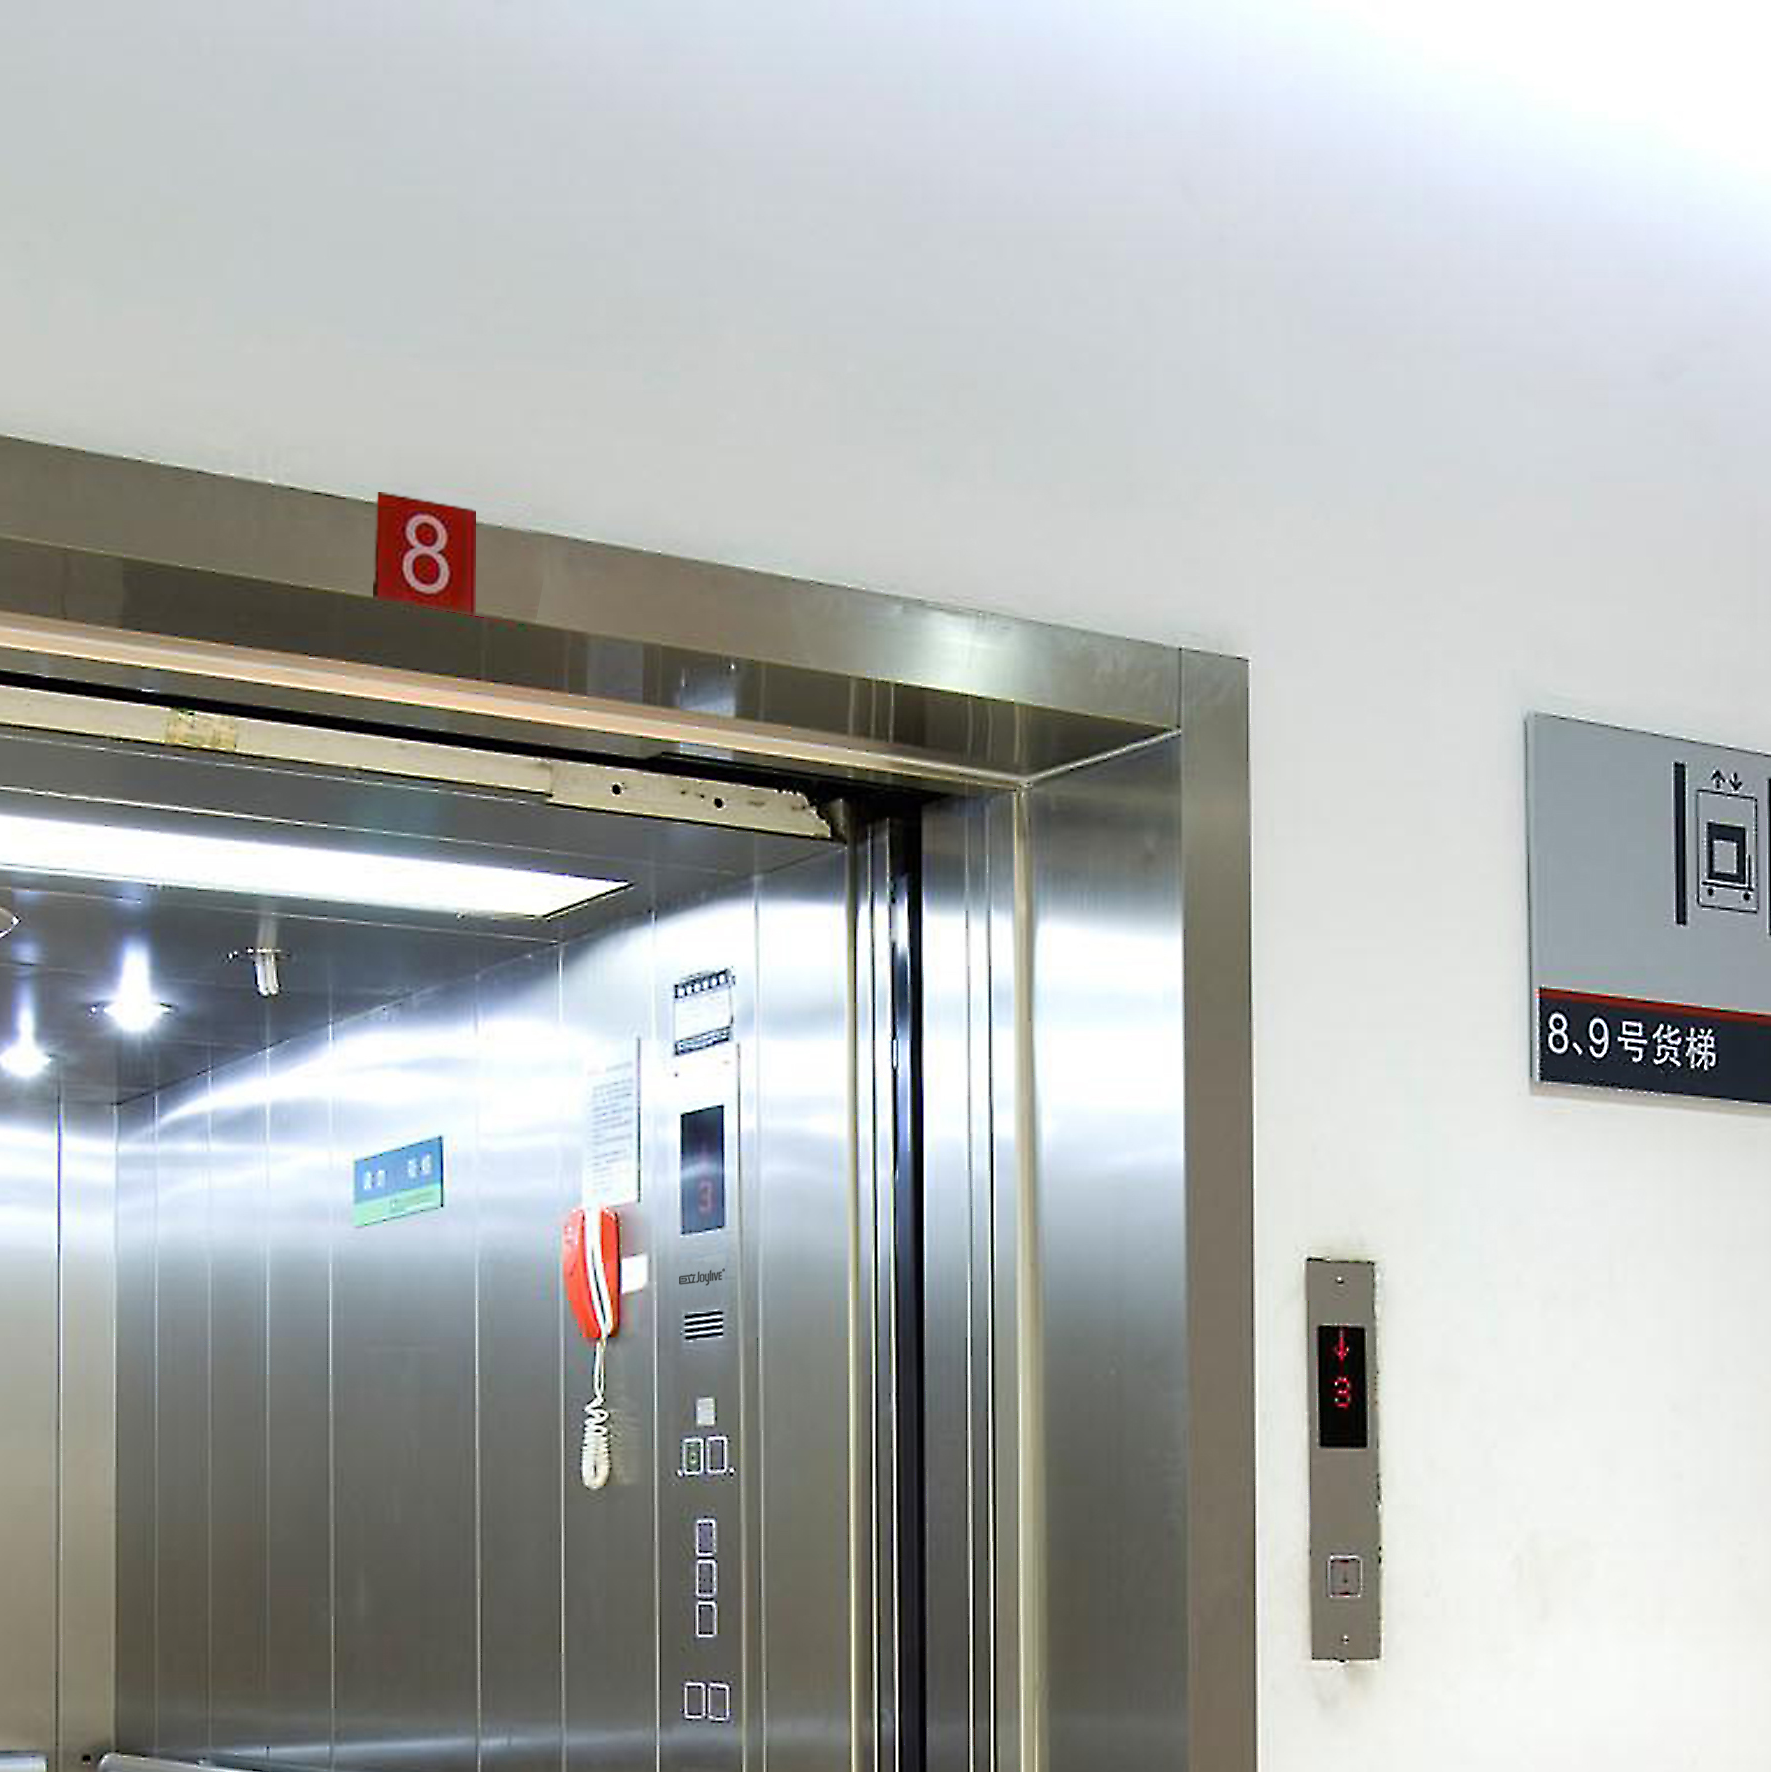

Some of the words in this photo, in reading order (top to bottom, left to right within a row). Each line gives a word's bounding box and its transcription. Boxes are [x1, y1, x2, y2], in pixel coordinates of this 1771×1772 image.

[402, 513, 450, 595] 8
[1547, 1011, 1718, 1071] 8、9号货梯
[1334, 1376, 1350, 1408] 3
